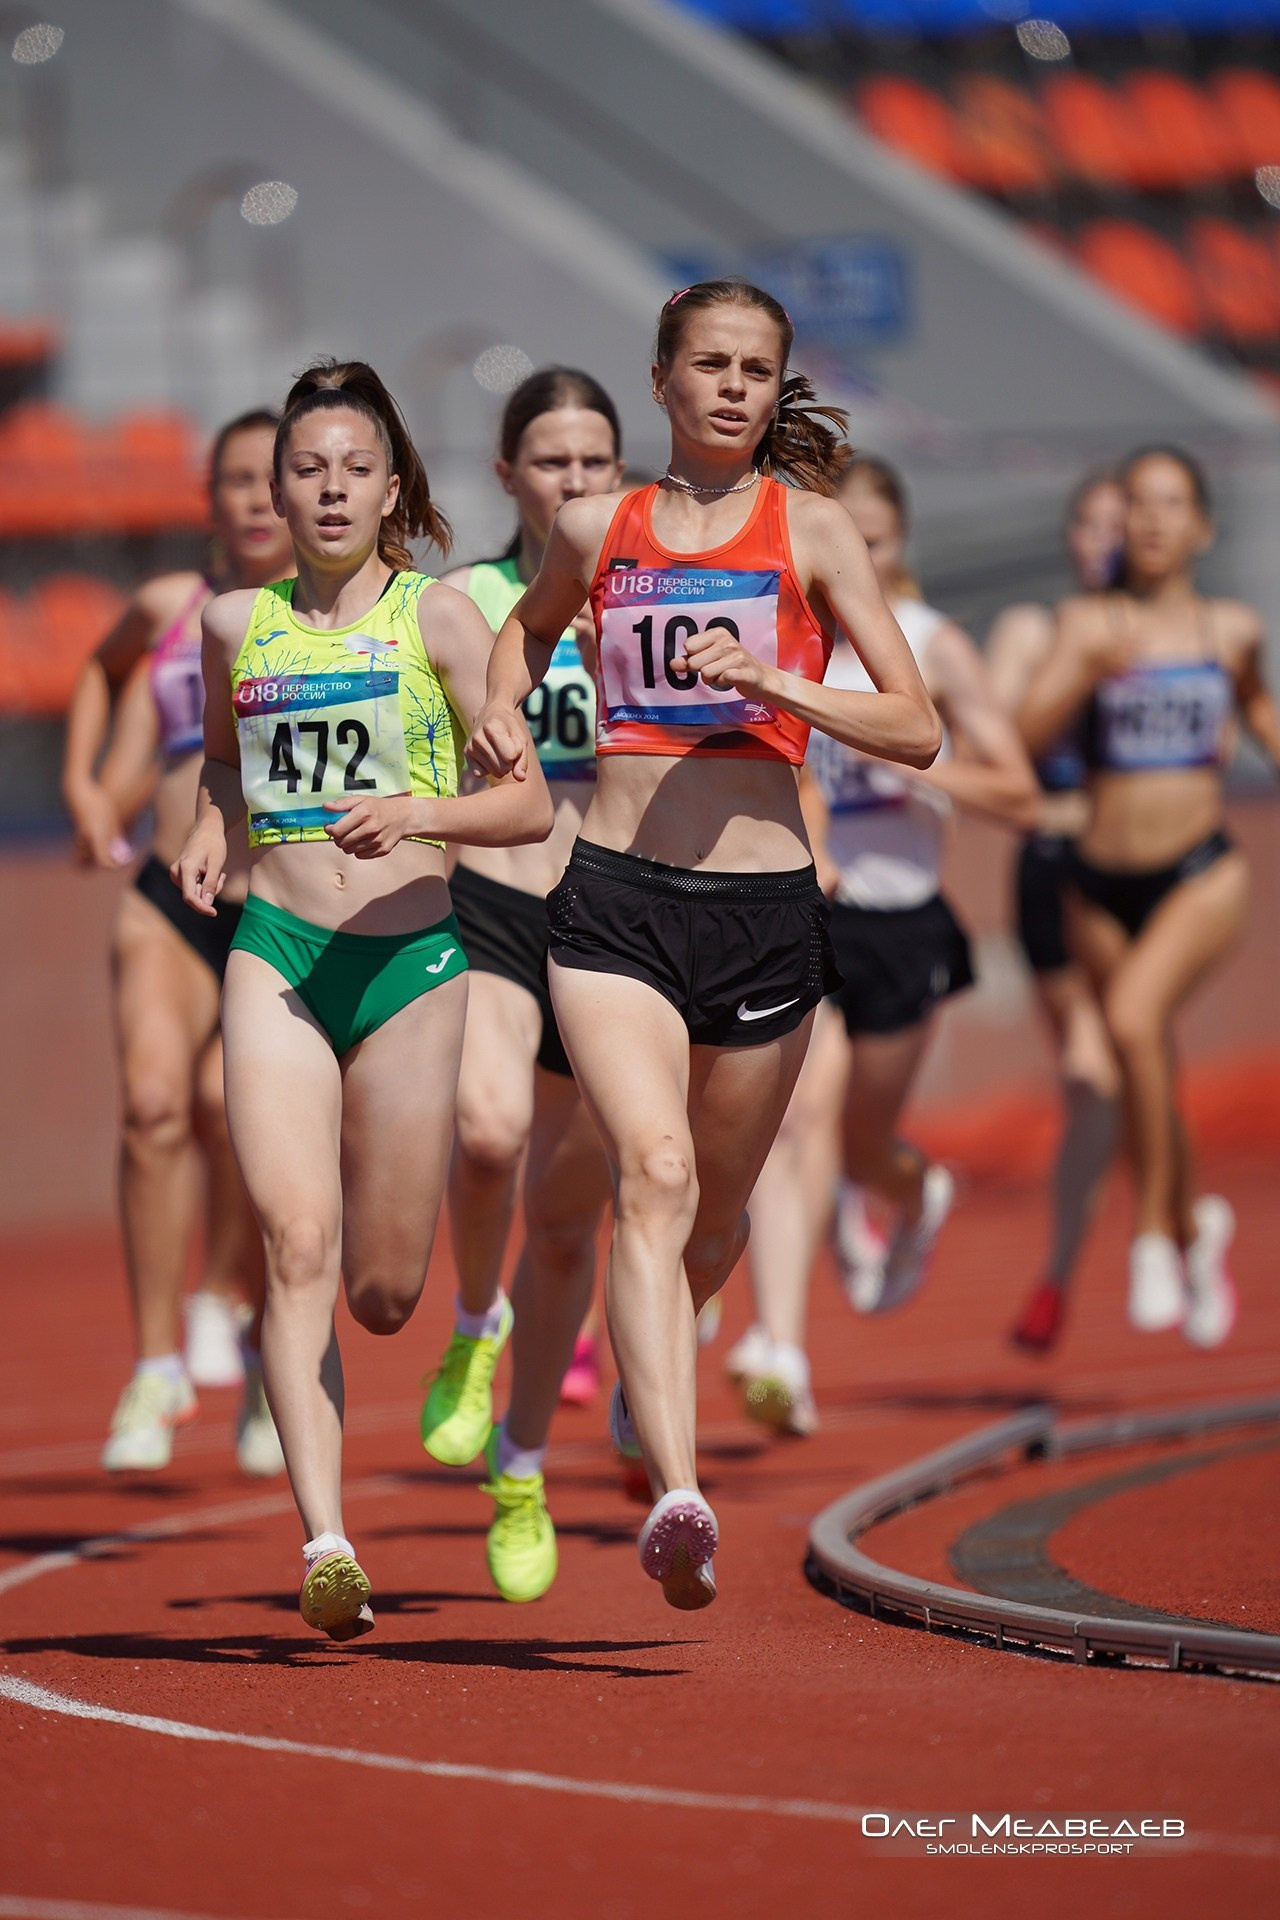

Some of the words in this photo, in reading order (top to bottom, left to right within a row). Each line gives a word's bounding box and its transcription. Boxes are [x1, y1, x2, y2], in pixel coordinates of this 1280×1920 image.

[611, 575, 654, 595] U18
[657, 577, 733, 588] ПЕРВЕНСТВО
[657, 586, 705, 595] РОССИИ
[282, 681, 352, 692] ПЕРВЕНСТВО
[239, 682, 278, 703] U18
[282, 691, 326, 701] РОССИИ
[269, 719, 377, 793] 472
